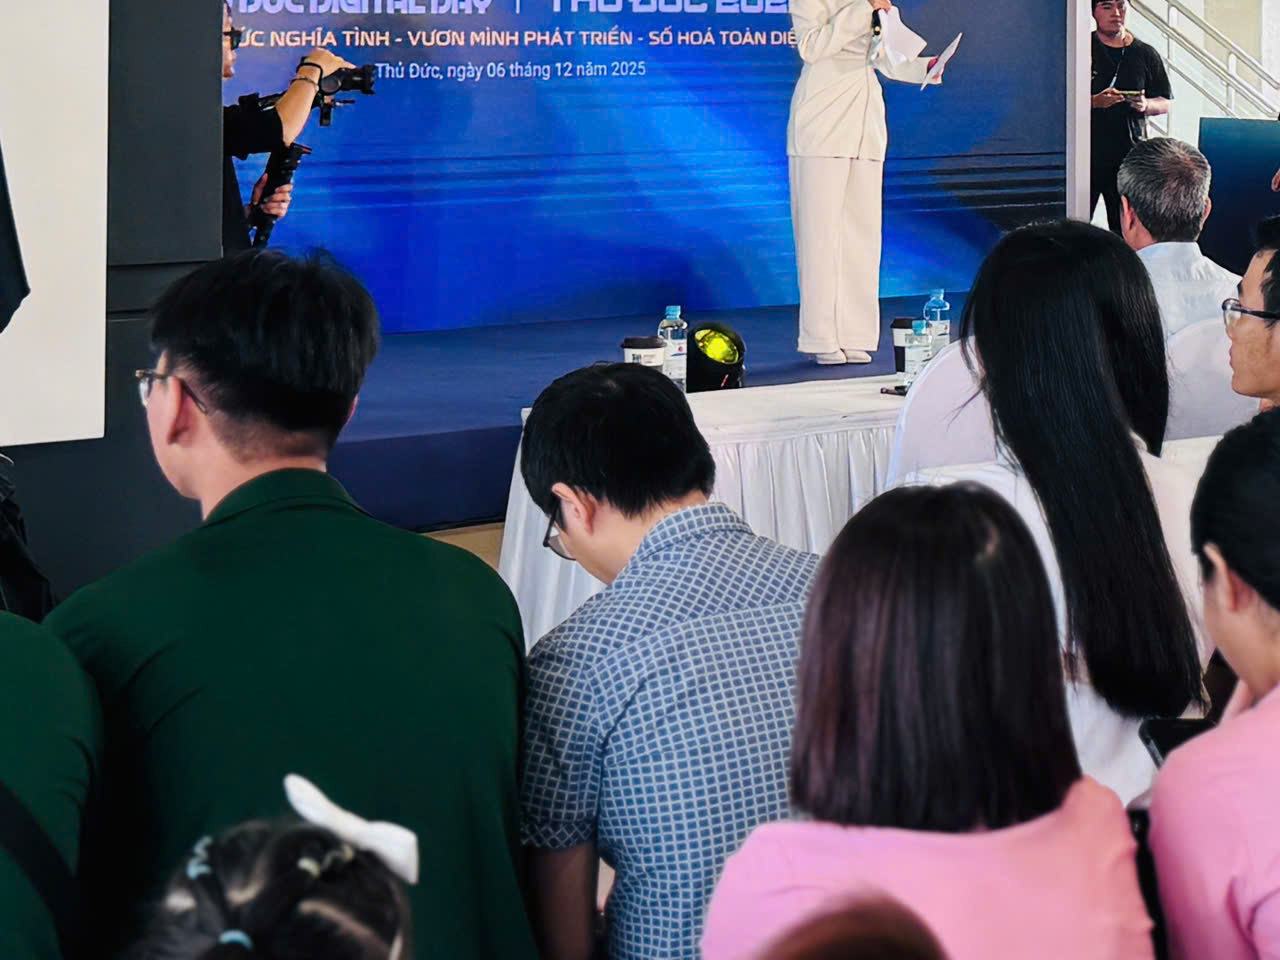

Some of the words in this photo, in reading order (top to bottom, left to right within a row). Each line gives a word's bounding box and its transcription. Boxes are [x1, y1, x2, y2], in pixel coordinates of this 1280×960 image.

[270, 27, 337, 47] NGHĨA
[342, 26, 390, 47] TÌNH
[407, 30, 465, 46] VƯƠN
[470, 27, 519, 46] MÌNH
[524, 27, 576, 46] PHÁT
[649, 24, 673, 46] SỐ
[678, 27, 713, 46] HOÁ
[719, 27, 766, 46] TOÀN
[770, 29, 798, 48] DIỆ
[375, 61, 404, 78] Thủ
[447, 62, 483, 82] ngày
[487, 62, 506, 78] 06
[509, 62, 551, 81] tháng
[555, 62, 572, 77] 12
[576, 61, 607, 76] năm
[610, 60, 646, 76] 2025
